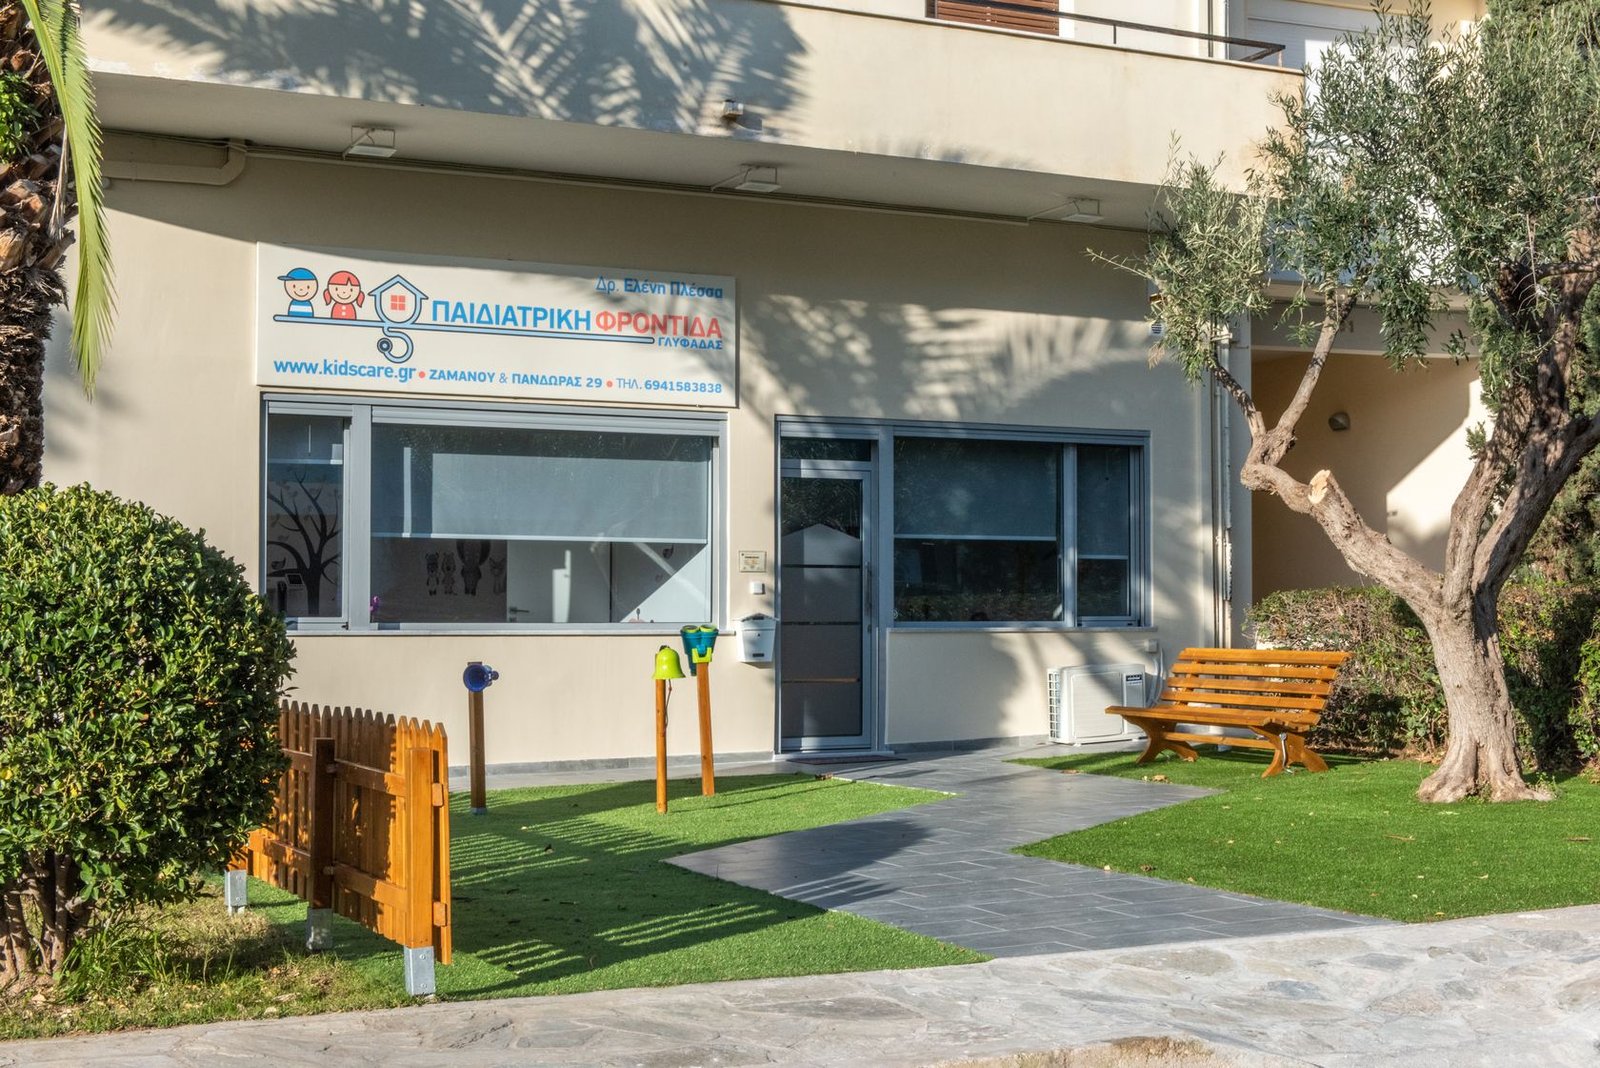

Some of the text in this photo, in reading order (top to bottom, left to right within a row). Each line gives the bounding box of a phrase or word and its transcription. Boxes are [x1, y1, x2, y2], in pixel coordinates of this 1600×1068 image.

[595, 276, 723, 299] Δρ. Ελένη Πλέσσα
[432, 300, 723, 338] ΠΑΙΔΙΑΤΡΙΚΗ ΦΡΟΝΤΙΔΑ
[658, 337, 723, 350] ΓΛΥΦΑΔΑΣ
[274, 359, 416, 382] www.kidscare.gr
[429, 368, 496, 382] ΖΑΜΑΝΟΥ
[499, 372, 508, 383] &
[512, 373, 582, 387] ΠΑΝΔΩΡΑΣ
[586, 377, 603, 388] 29
